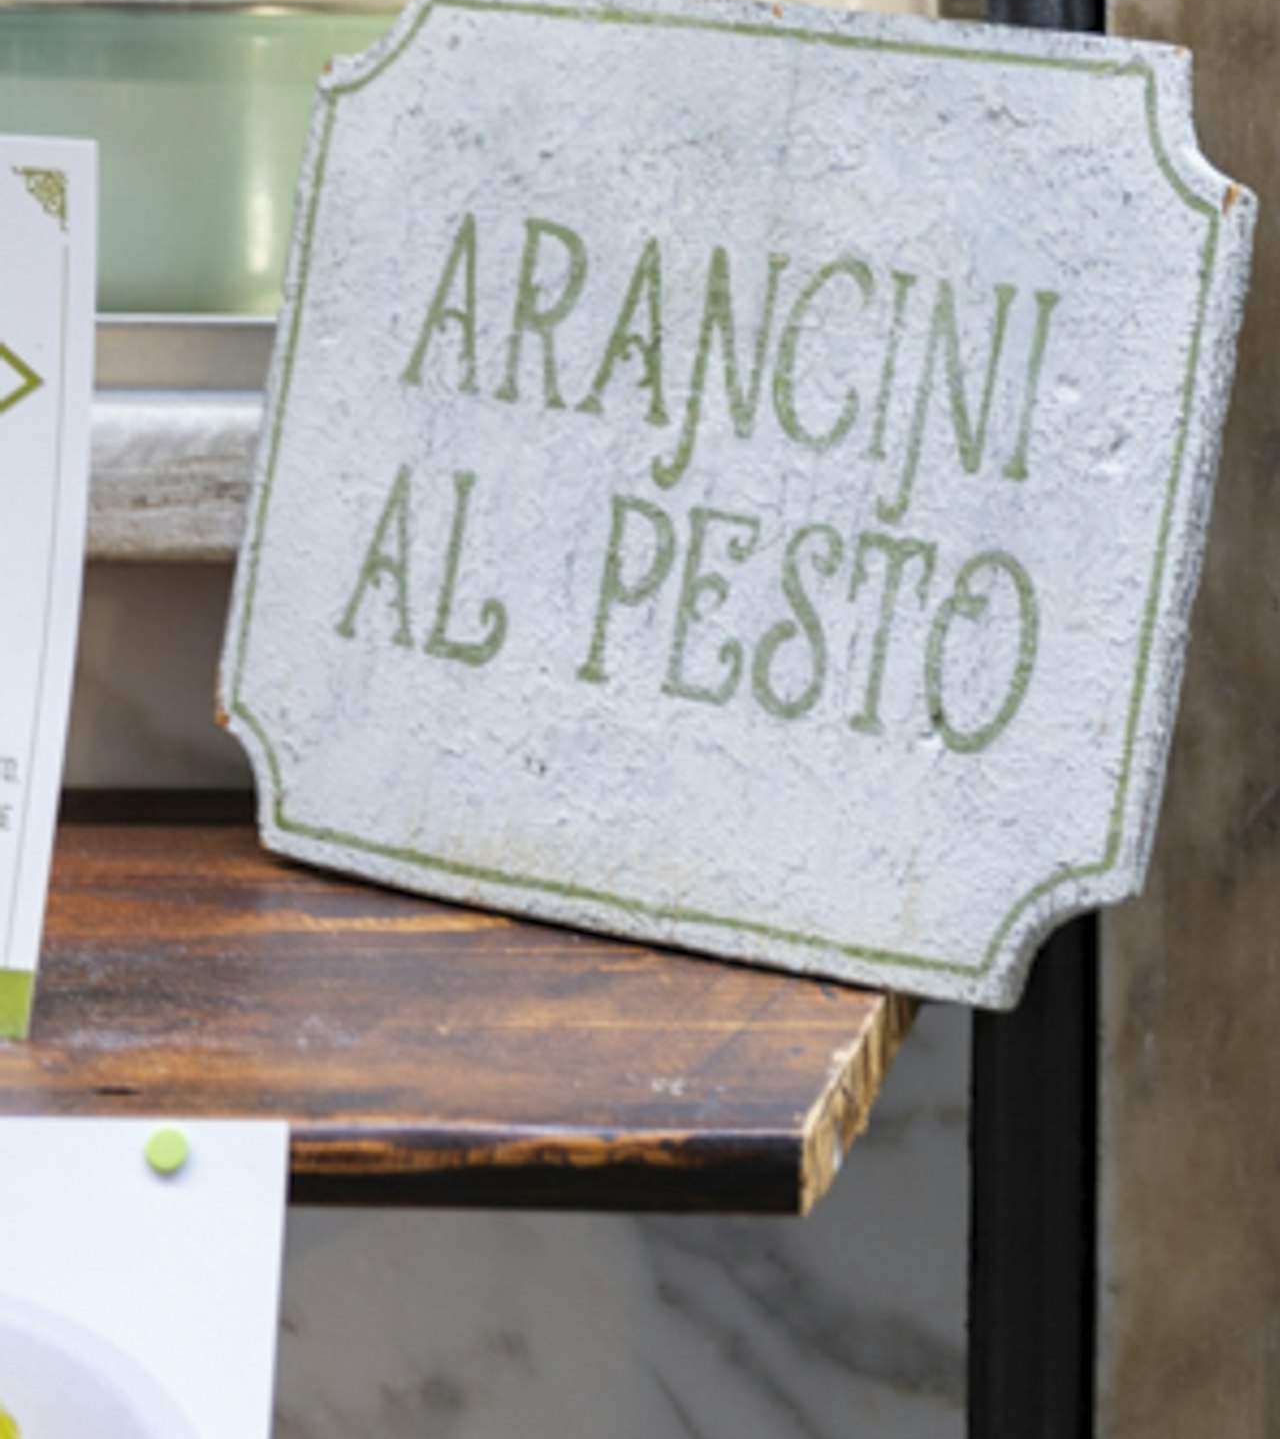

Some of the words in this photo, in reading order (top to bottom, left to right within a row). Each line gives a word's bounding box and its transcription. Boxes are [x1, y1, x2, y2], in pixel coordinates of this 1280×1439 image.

[401, 211, 1061, 522] ARANCINI
[335, 462, 508, 667] AL
[575, 492, 1042, 753] PESTO
